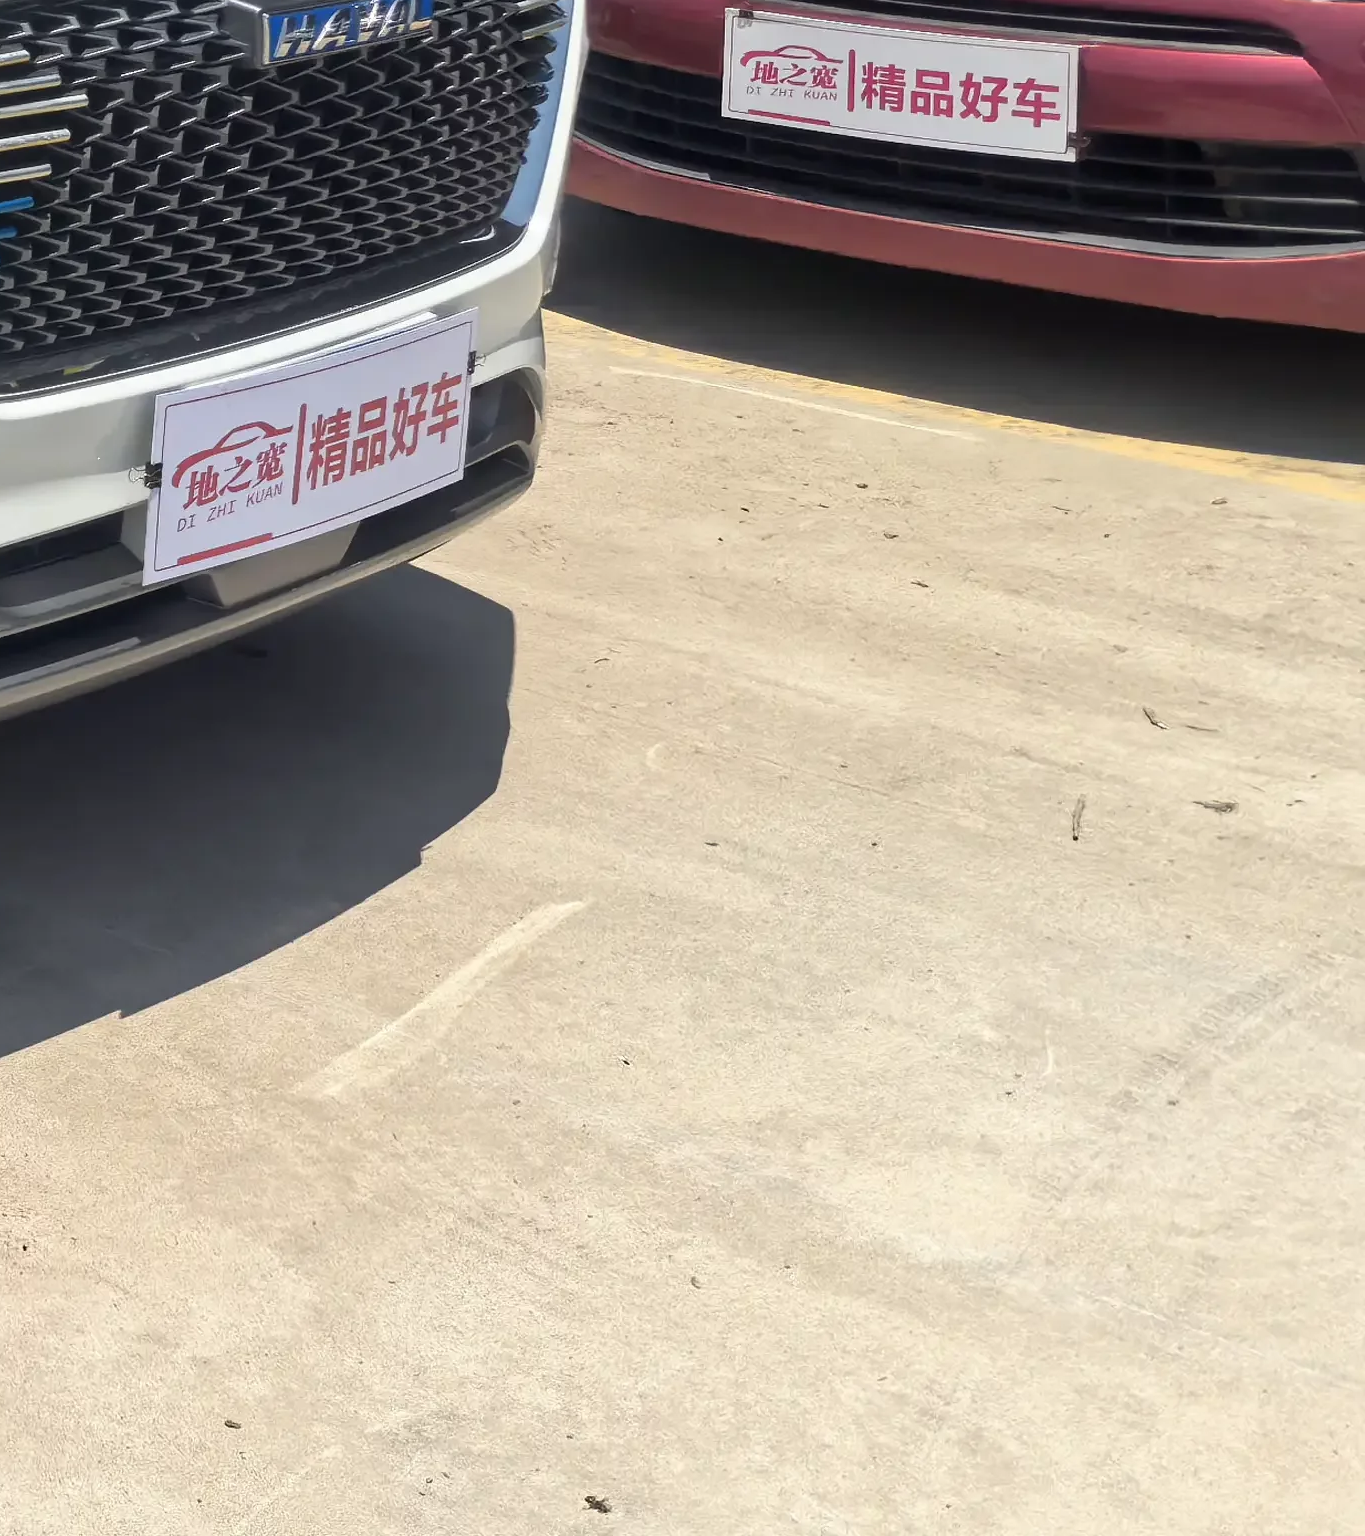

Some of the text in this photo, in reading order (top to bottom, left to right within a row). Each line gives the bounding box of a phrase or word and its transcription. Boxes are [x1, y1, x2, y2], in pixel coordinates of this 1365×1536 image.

[804, 90, 838, 101] KUAN
[860, 61, 1062, 128] 精品好车
[306, 371, 463, 491] 精品好车
[176, 480, 284, 532] DI ZHI KUAN
